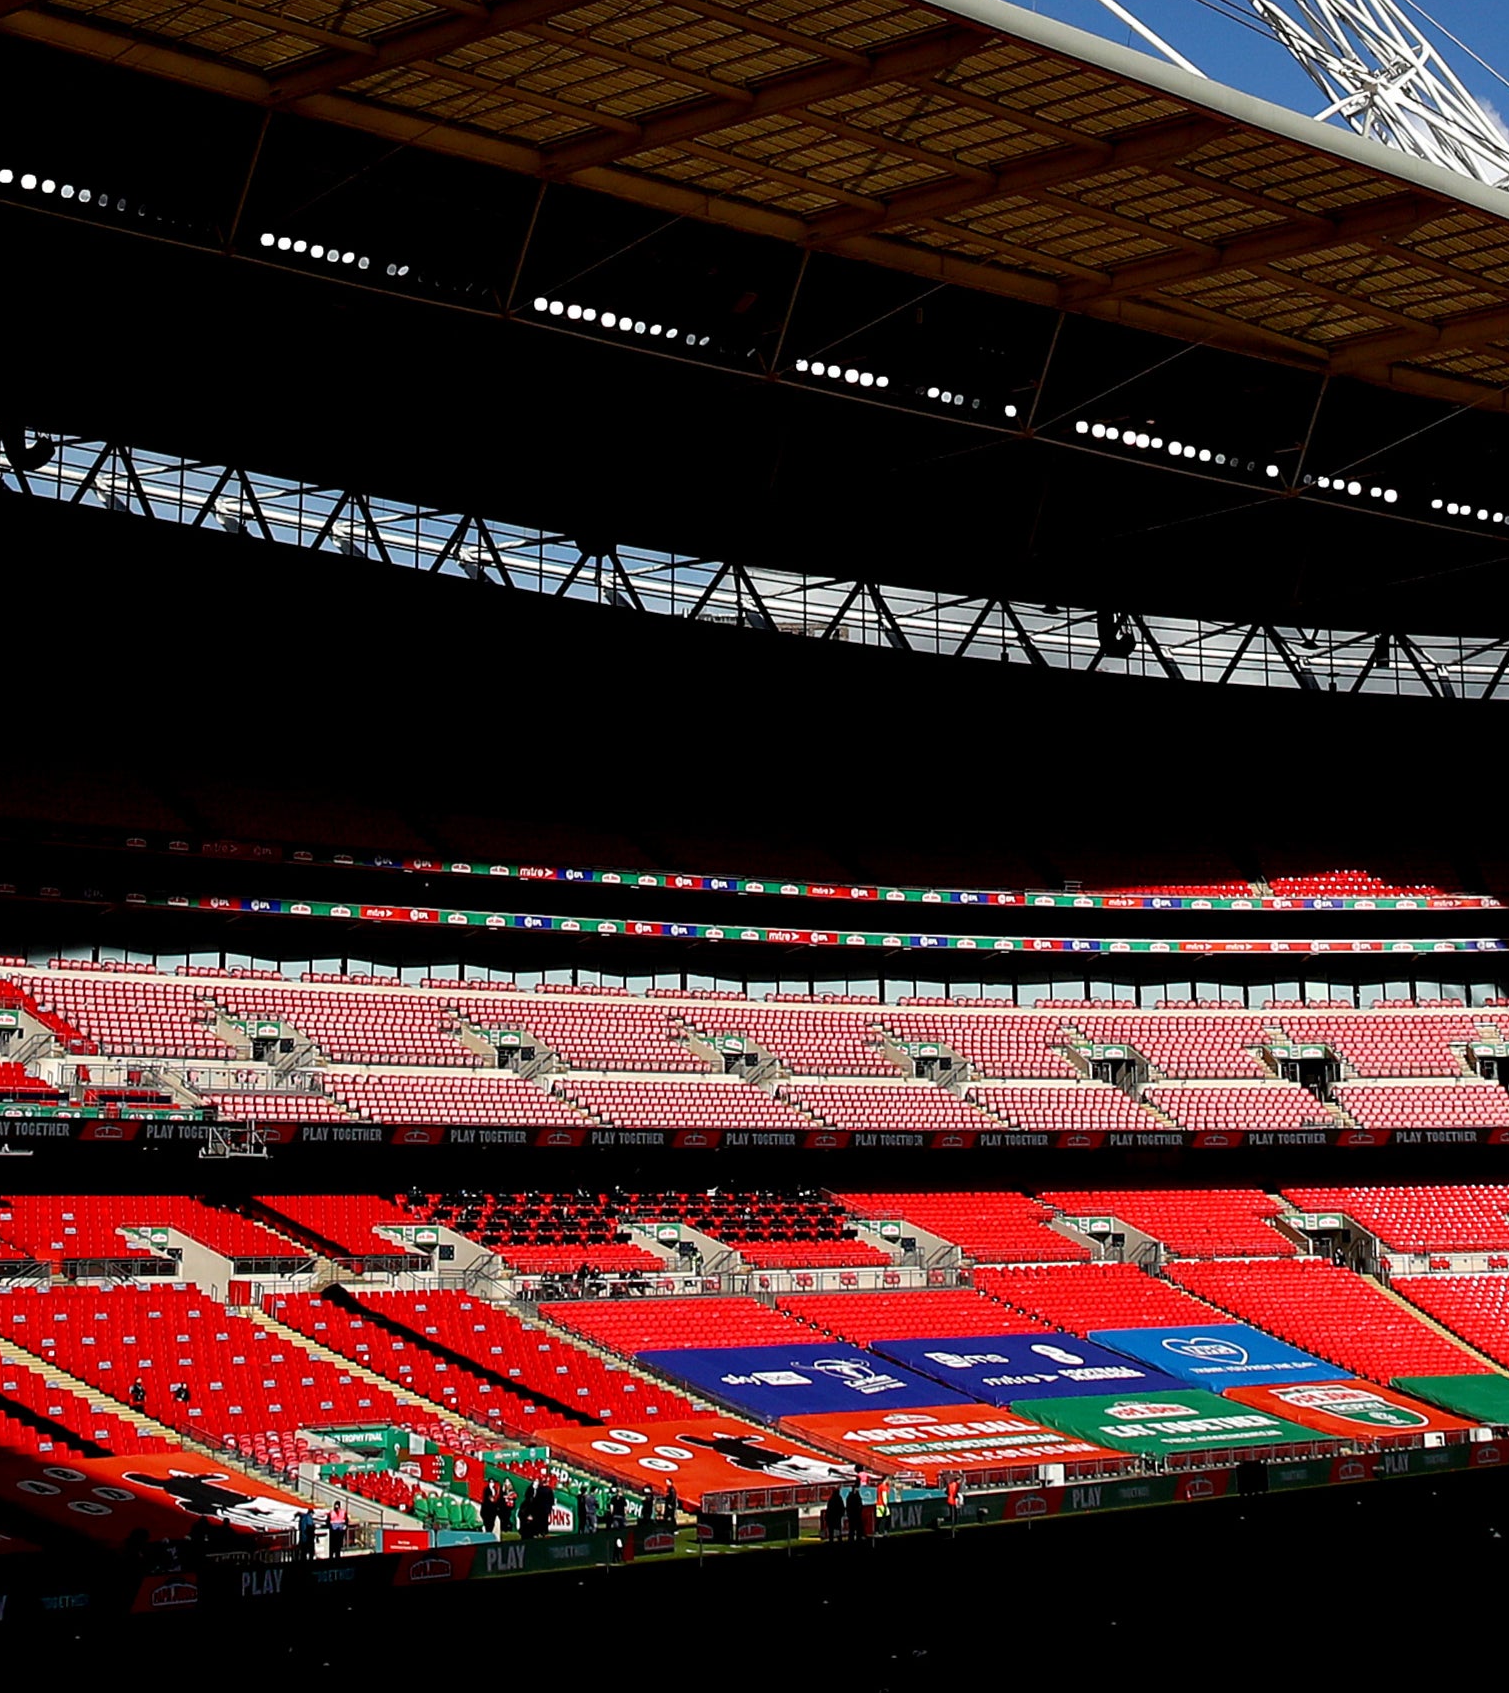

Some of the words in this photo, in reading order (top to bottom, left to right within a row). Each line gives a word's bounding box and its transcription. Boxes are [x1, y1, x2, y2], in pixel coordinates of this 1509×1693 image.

[519, 868, 547, 878] mitre
[15, 1122, 71, 1136] TOGETHER
[146, 1125, 174, 1139] PLAY
[302, 1127, 329, 1140] PLAY
[333, 1127, 383, 1141] TOGETHER
[450, 1129, 476, 1142] PLAY
[479, 1130, 527, 1143] TOGETHER
[591, 1131, 616, 1144] PLAY
[619, 1132, 665, 1145] TOGETHER
[726, 1132, 751, 1145] PLAY
[752, 1132, 796, 1145] TOGETHER
[855, 1133, 878, 1145] PLAY
[880, 1133, 924, 1146] TOGETHER
[980, 1133, 1002, 1145] PLAY
[1003, 1133, 1049, 1145] TOGETHER
[1110, 1133, 1135, 1145] PLAY
[1137, 1133, 1183, 1145] TOGETHER
[1249, 1132, 1273, 1145] PLAY
[1278, 1132, 1327, 1144] TOGETHER
[1396, 1130, 1421, 1143] PLAY
[1425, 1130, 1478, 1142] TOGETHER
[1072, 1486, 1102, 1509] PLAY
[891, 1505, 923, 1529] PLAY
[487, 1544, 526, 1571] PLAY
[241, 1568, 283, 1598] PLAY
